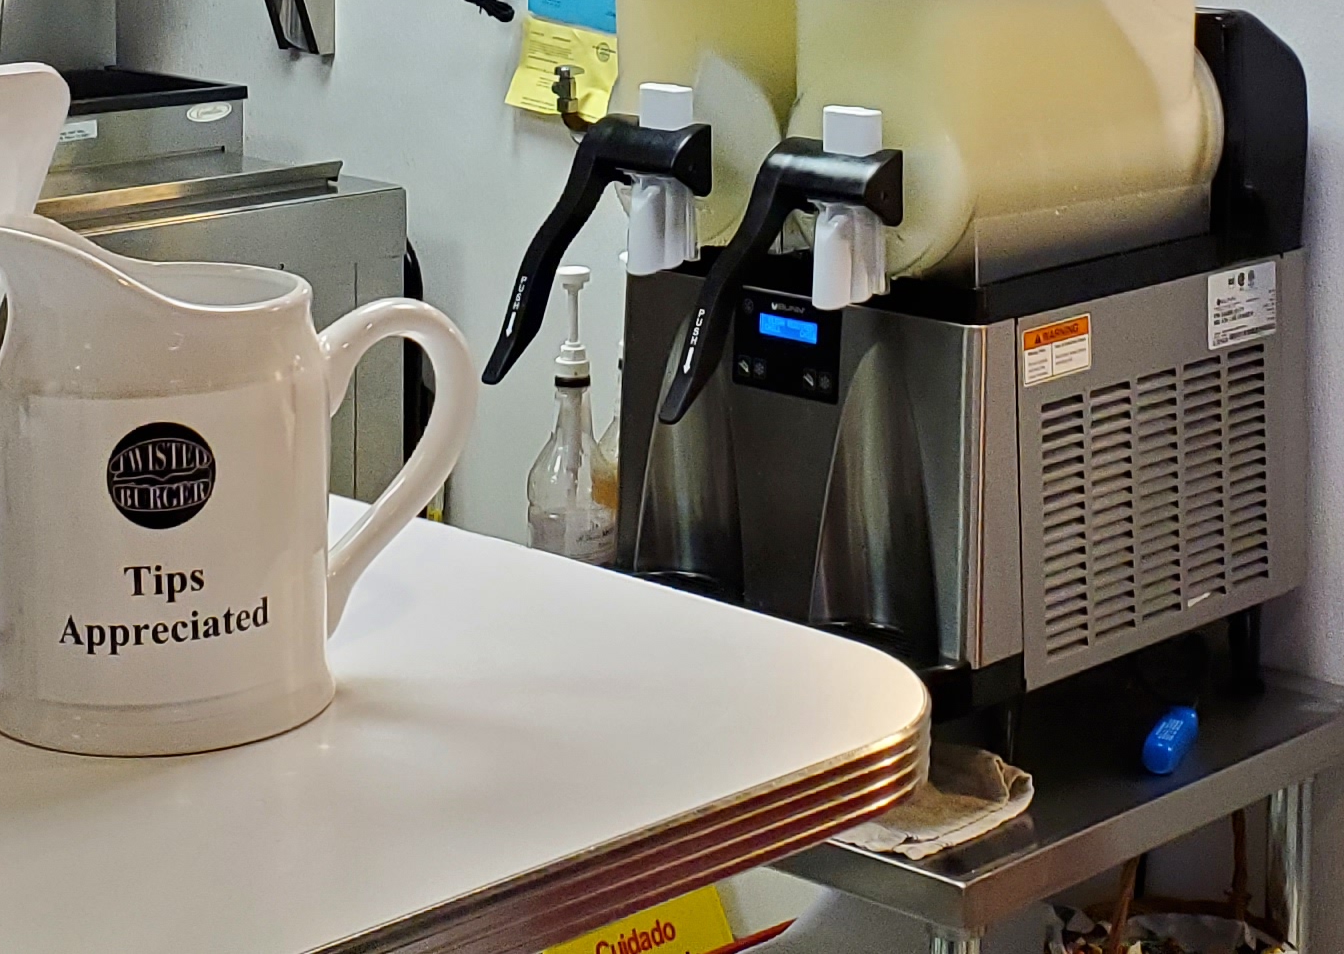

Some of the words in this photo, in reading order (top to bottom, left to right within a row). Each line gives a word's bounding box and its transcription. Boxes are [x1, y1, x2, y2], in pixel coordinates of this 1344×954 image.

[512, 275, 528, 311] PUSH
[691, 308, 706, 346] PUSH
[1042, 322, 1079, 342] WARNING
[117, 441, 210, 475] TWISTED
[119, 481, 207, 510] BURGER
[123, 565, 205, 603] Tips
[58, 595, 270, 656] Appreciated
[595, 918, 678, 954] Cuidado
